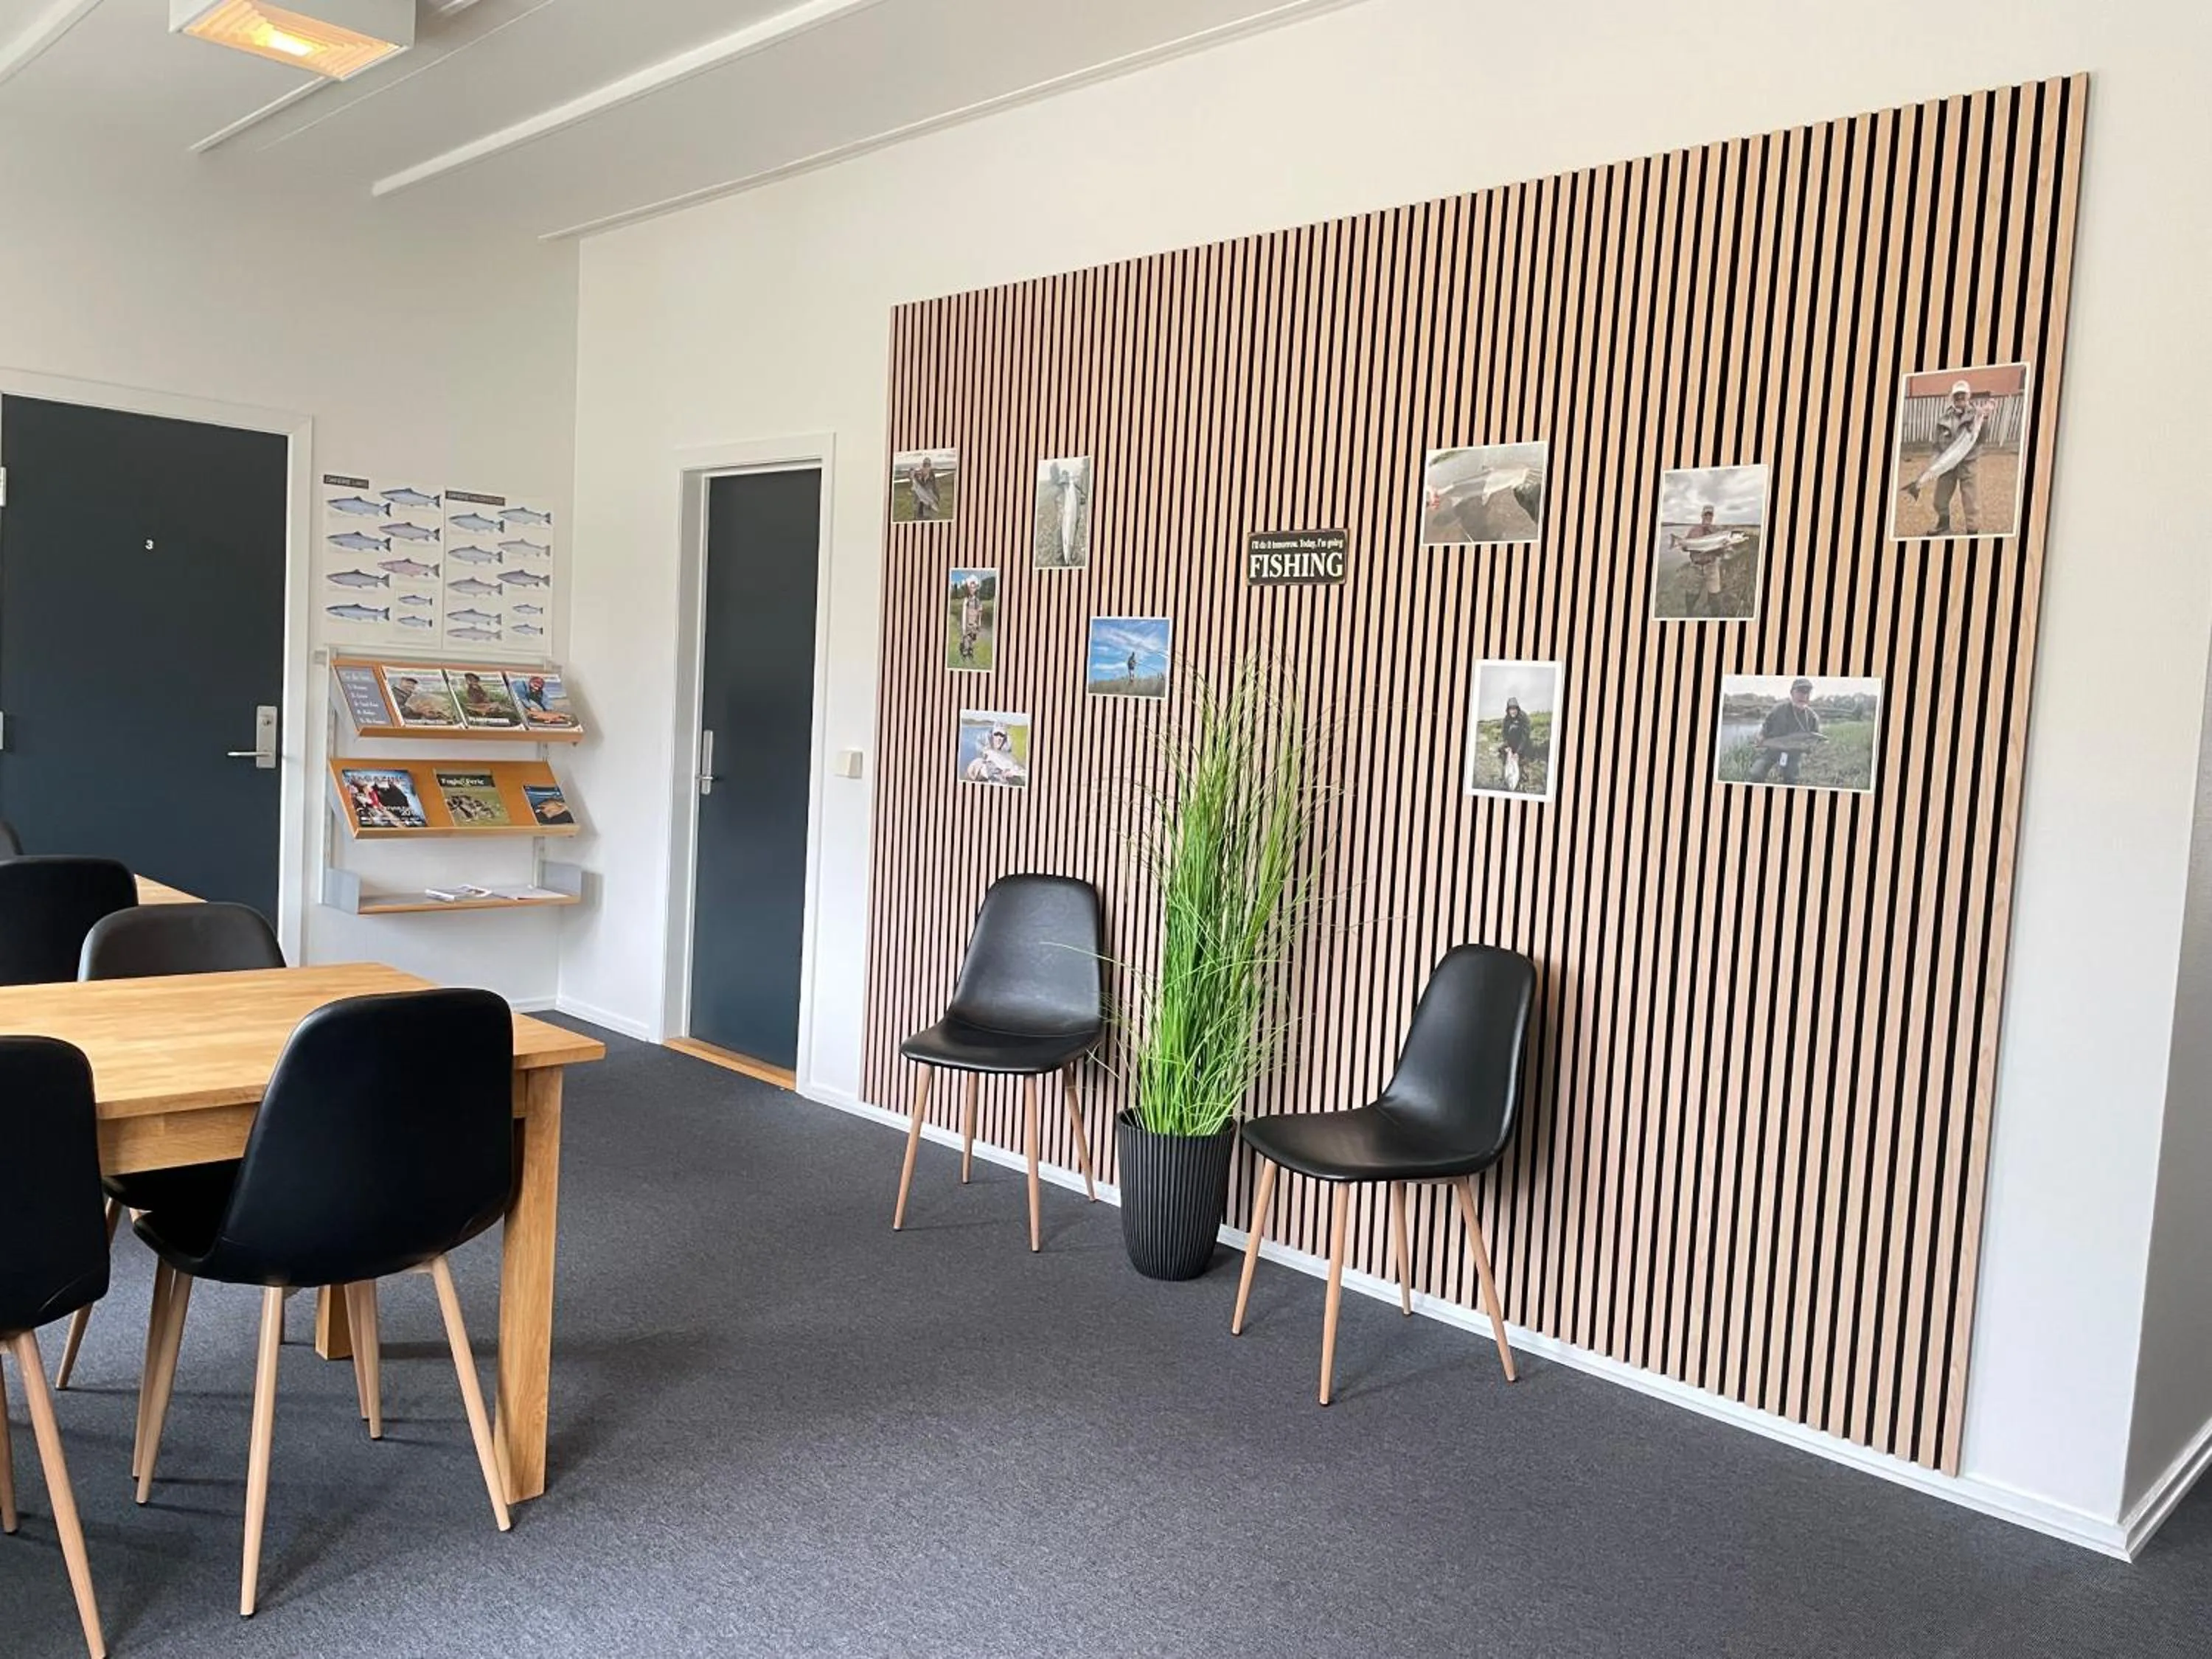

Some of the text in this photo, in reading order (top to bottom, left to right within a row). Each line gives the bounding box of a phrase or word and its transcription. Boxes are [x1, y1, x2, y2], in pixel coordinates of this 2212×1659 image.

[145, 538, 154, 549] 3
[1259, 540, 1267, 549] do
[1327, 538, 1343, 549] going
[1249, 552, 1343, 579] FISHING
